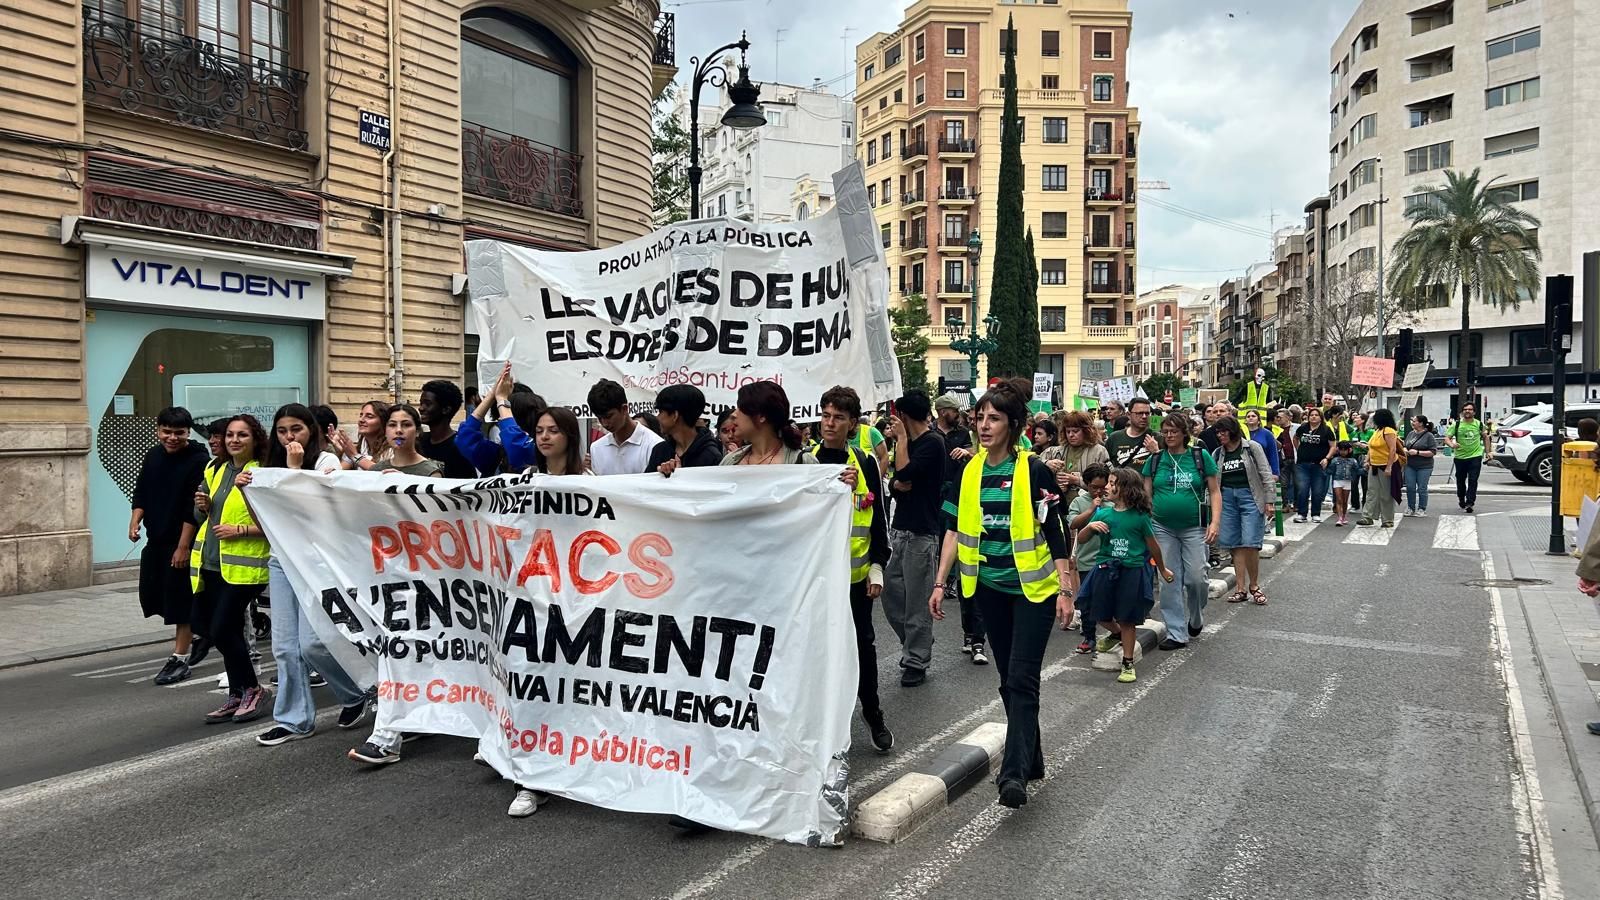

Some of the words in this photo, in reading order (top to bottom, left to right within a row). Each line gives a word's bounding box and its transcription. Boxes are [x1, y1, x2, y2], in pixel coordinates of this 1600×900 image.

[361, 130, 390, 148] RUZAFA
[362, 112, 390, 129] CALLE
[372, 126, 380, 134] DE
[598, 252, 641, 276] PROU
[644, 230, 676, 263] ATACS
[679, 231, 691, 246] A
[695, 228, 717, 245] LA
[723, 227, 813, 249] PÚBLICA
[111, 257, 311, 300] VITALDENT
[729, 270, 794, 310] DE
[545, 329, 604, 363] ELS
[684, 316, 749, 356] DE
[757, 301, 852, 357] DEMÀ
[792, 404, 812, 419] EN
[487, 489, 617, 521] INDEFINIDA
[368, 519, 484, 574] PROU
[488, 525, 675, 600] ATACS
[321, 587, 365, 635] A
[557, 677, 566, 705] I
[572, 678, 613, 707] EN
[619, 683, 761, 733] VALENCIÀ
[569, 729, 693, 776] pública!
